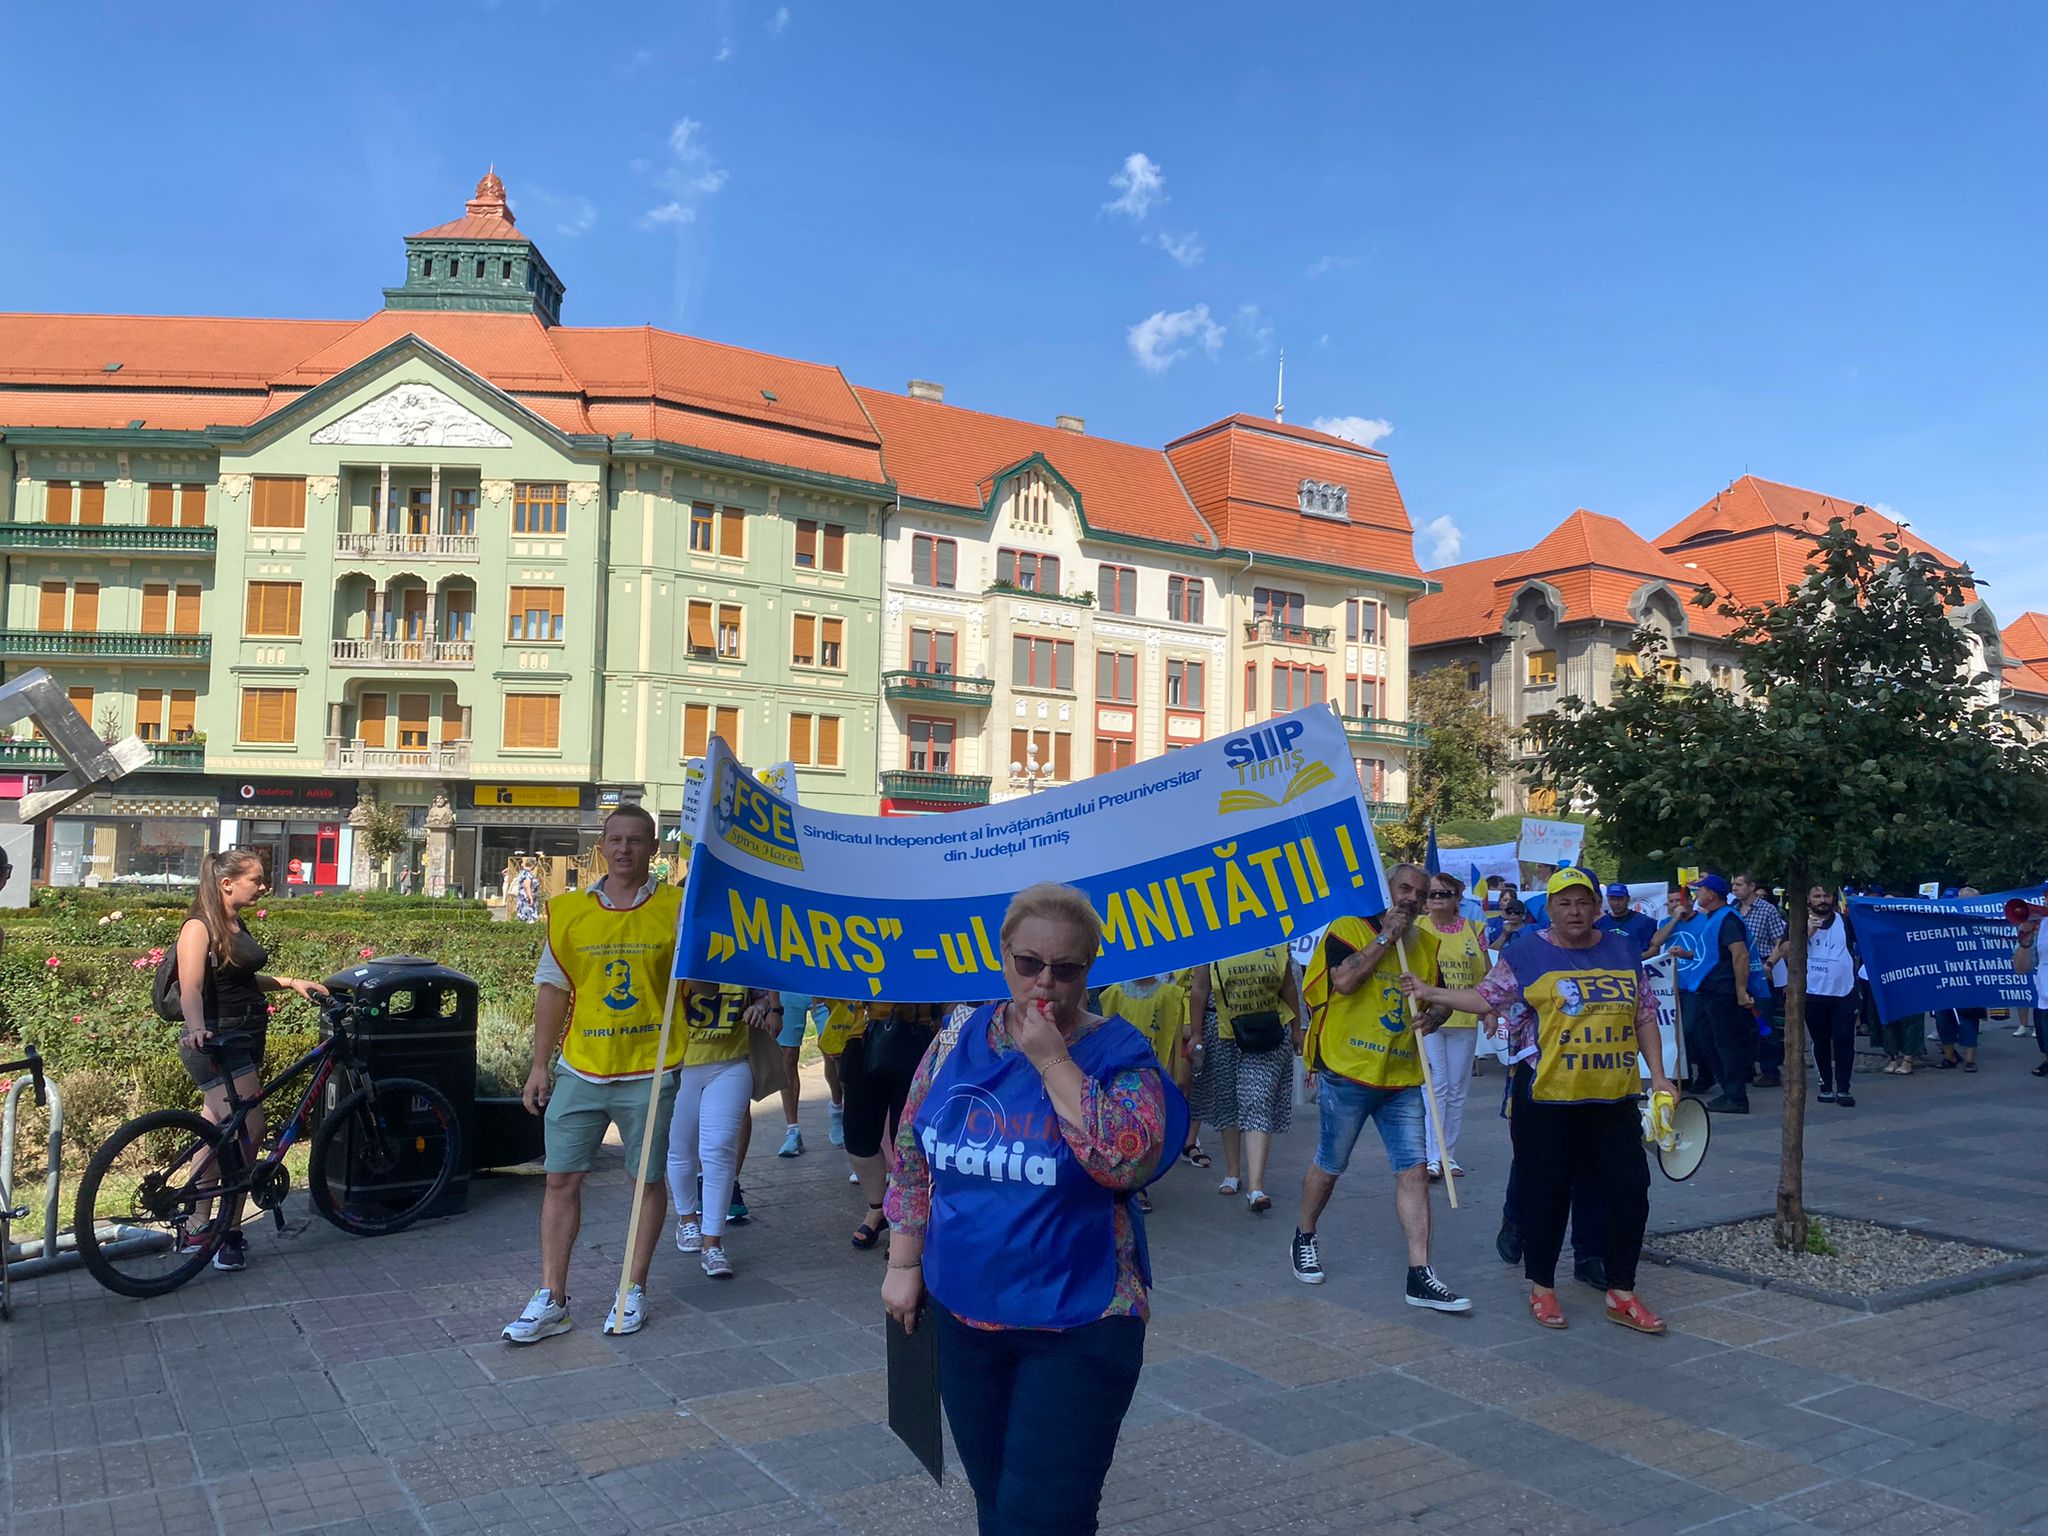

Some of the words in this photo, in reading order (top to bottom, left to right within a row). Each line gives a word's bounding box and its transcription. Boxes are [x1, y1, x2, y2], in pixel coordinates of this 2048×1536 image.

[1223, 720, 1304, 768] SIIP
[1232, 748, 1305, 785] Timiș
[255, 788, 293, 797] vodafone
[733, 777, 795, 844] FSE
[803, 824, 872, 845] Sindicatul
[875, 830, 968, 848] Independent
[970, 827, 983, 841] al
[985, 799, 1095, 839] Învățământului
[1099, 767, 1202, 810] Preuniversitar
[731, 827, 759, 851] Spiru
[762, 845, 800, 865] Haret
[944, 850, 967, 862] din
[970, 838, 1026, 859] Județul
[1029, 829, 1070, 850] Timiș
[707, 888, 903, 997] „MARȘ”
[1097, 836, 1330, 957] MNITĂȚII
[1906, 926, 1968, 942] FEDERAȚIA
[1957, 940, 1977, 951] DIN
[1880, 963, 1941, 985] SINDICATUL
[1975, 974, 2028, 986] POPESCU
[1230, 1000, 1256, 1013] SPIRU
[1999, 989, 2033, 1002] TIMIȘ
[583, 1027, 616, 1038] SPIRU
[1350, 1038, 1386, 1053] SPIRU
[1561, 1050, 1636, 1075] TIMIȘ
